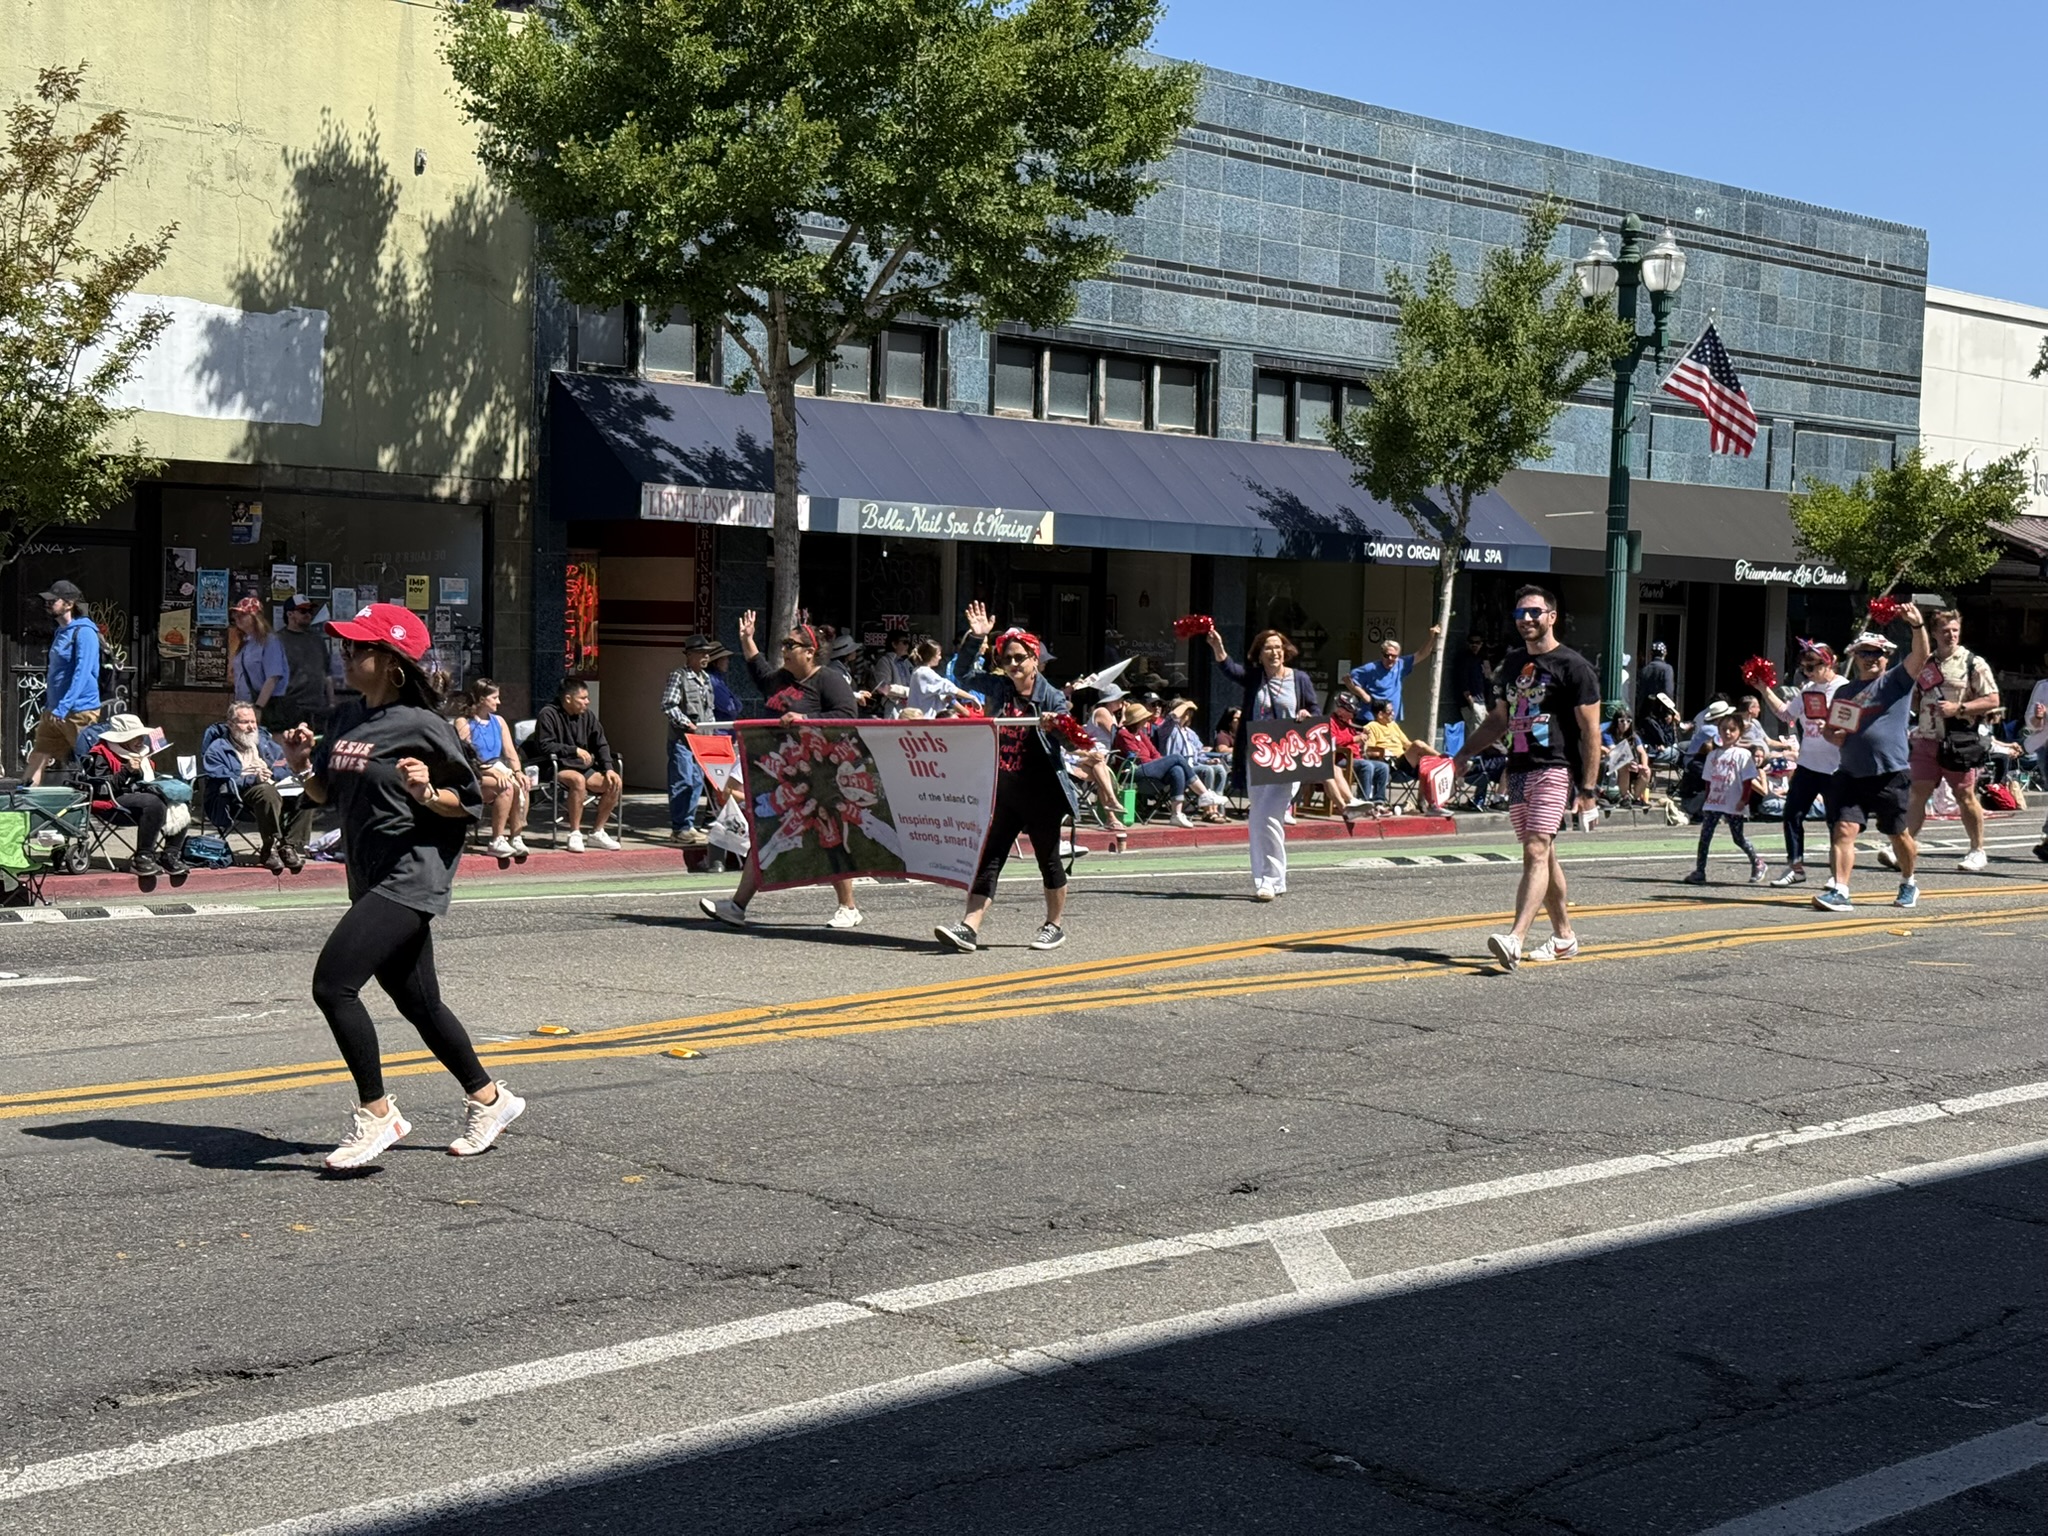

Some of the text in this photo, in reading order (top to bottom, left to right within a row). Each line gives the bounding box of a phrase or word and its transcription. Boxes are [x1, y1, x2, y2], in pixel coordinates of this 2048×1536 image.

[862, 502, 1033, 543] Bella Nail Spa & Waxing
[1363, 542, 1502, 563] TOMO'S ORGA NAIL SPA
[409, 578, 426, 586] IMP
[1735, 559, 1848, 588] Triumphant Life Church
[881, 613, 911, 633] TK
[898, 730, 948, 759] girls
[1251, 723, 1331, 773] SMART
[328, 755, 369, 772] SAVES
[907, 759, 947, 779] inc.
[918, 792, 927, 801] of
[928, 792, 941, 802] the
[943, 793, 966, 804] Island
[898, 813, 941, 830] Inspiring
[943, 815, 954, 828] all
[909, 831, 943, 845] strong,
[945, 834, 967, 848] smart
